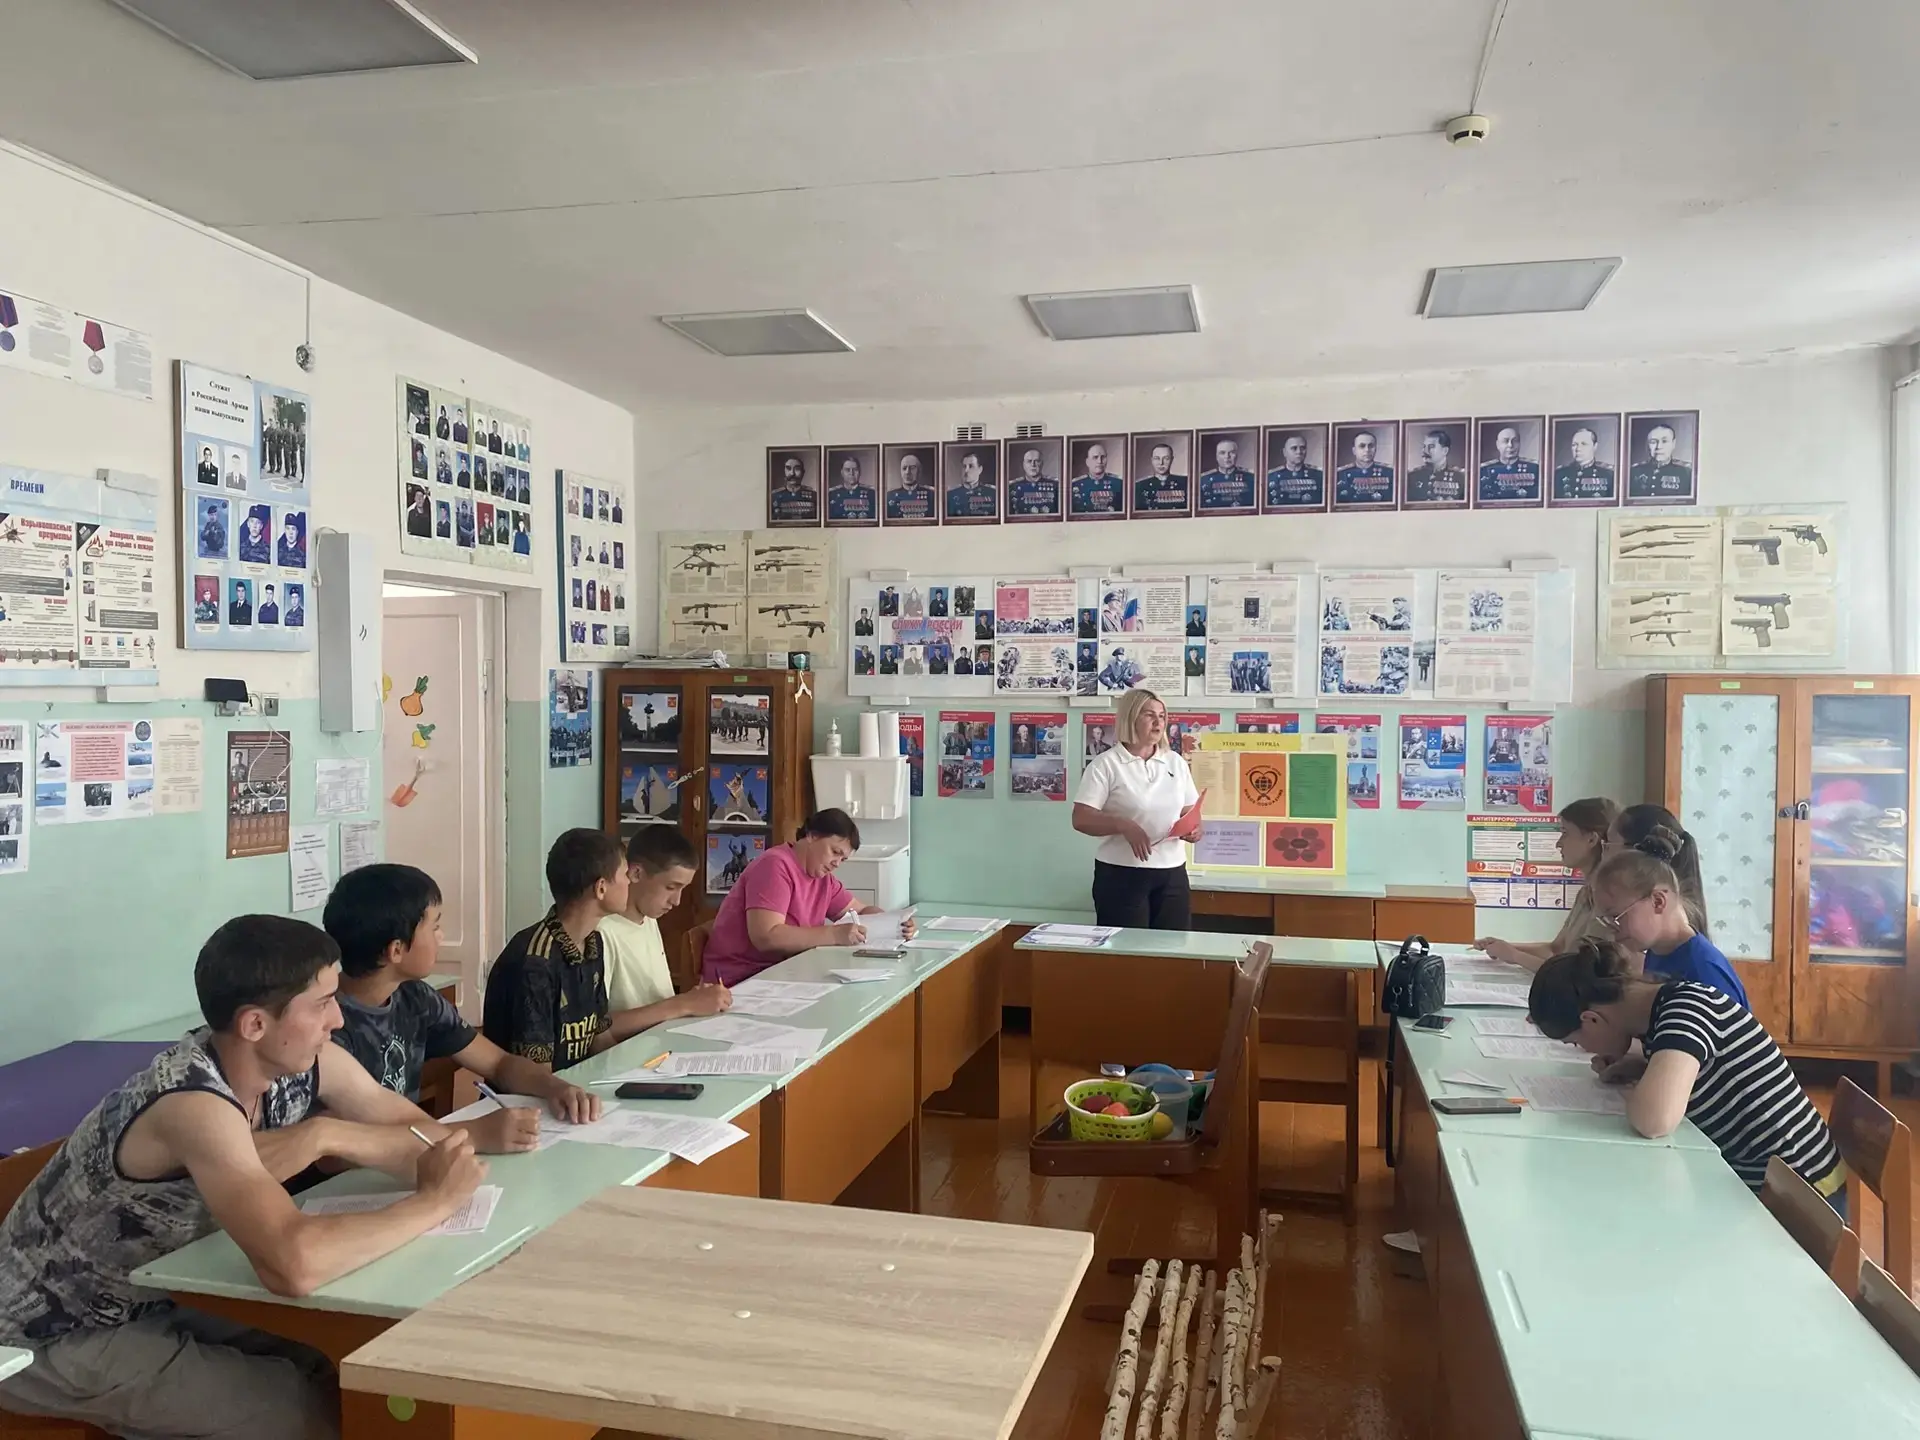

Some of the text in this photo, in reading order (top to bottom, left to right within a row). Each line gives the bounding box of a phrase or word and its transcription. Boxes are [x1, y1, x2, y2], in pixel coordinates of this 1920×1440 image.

[209, 380, 231, 392] Служат
[196, 390, 229, 406] Российской
[194, 406, 210, 415] наши
[10, 479, 45, 494] ВРЕМЕНИ
[927, 619, 963, 630] РОССИИ
[899, 724, 922, 732] ОДЦЫ
